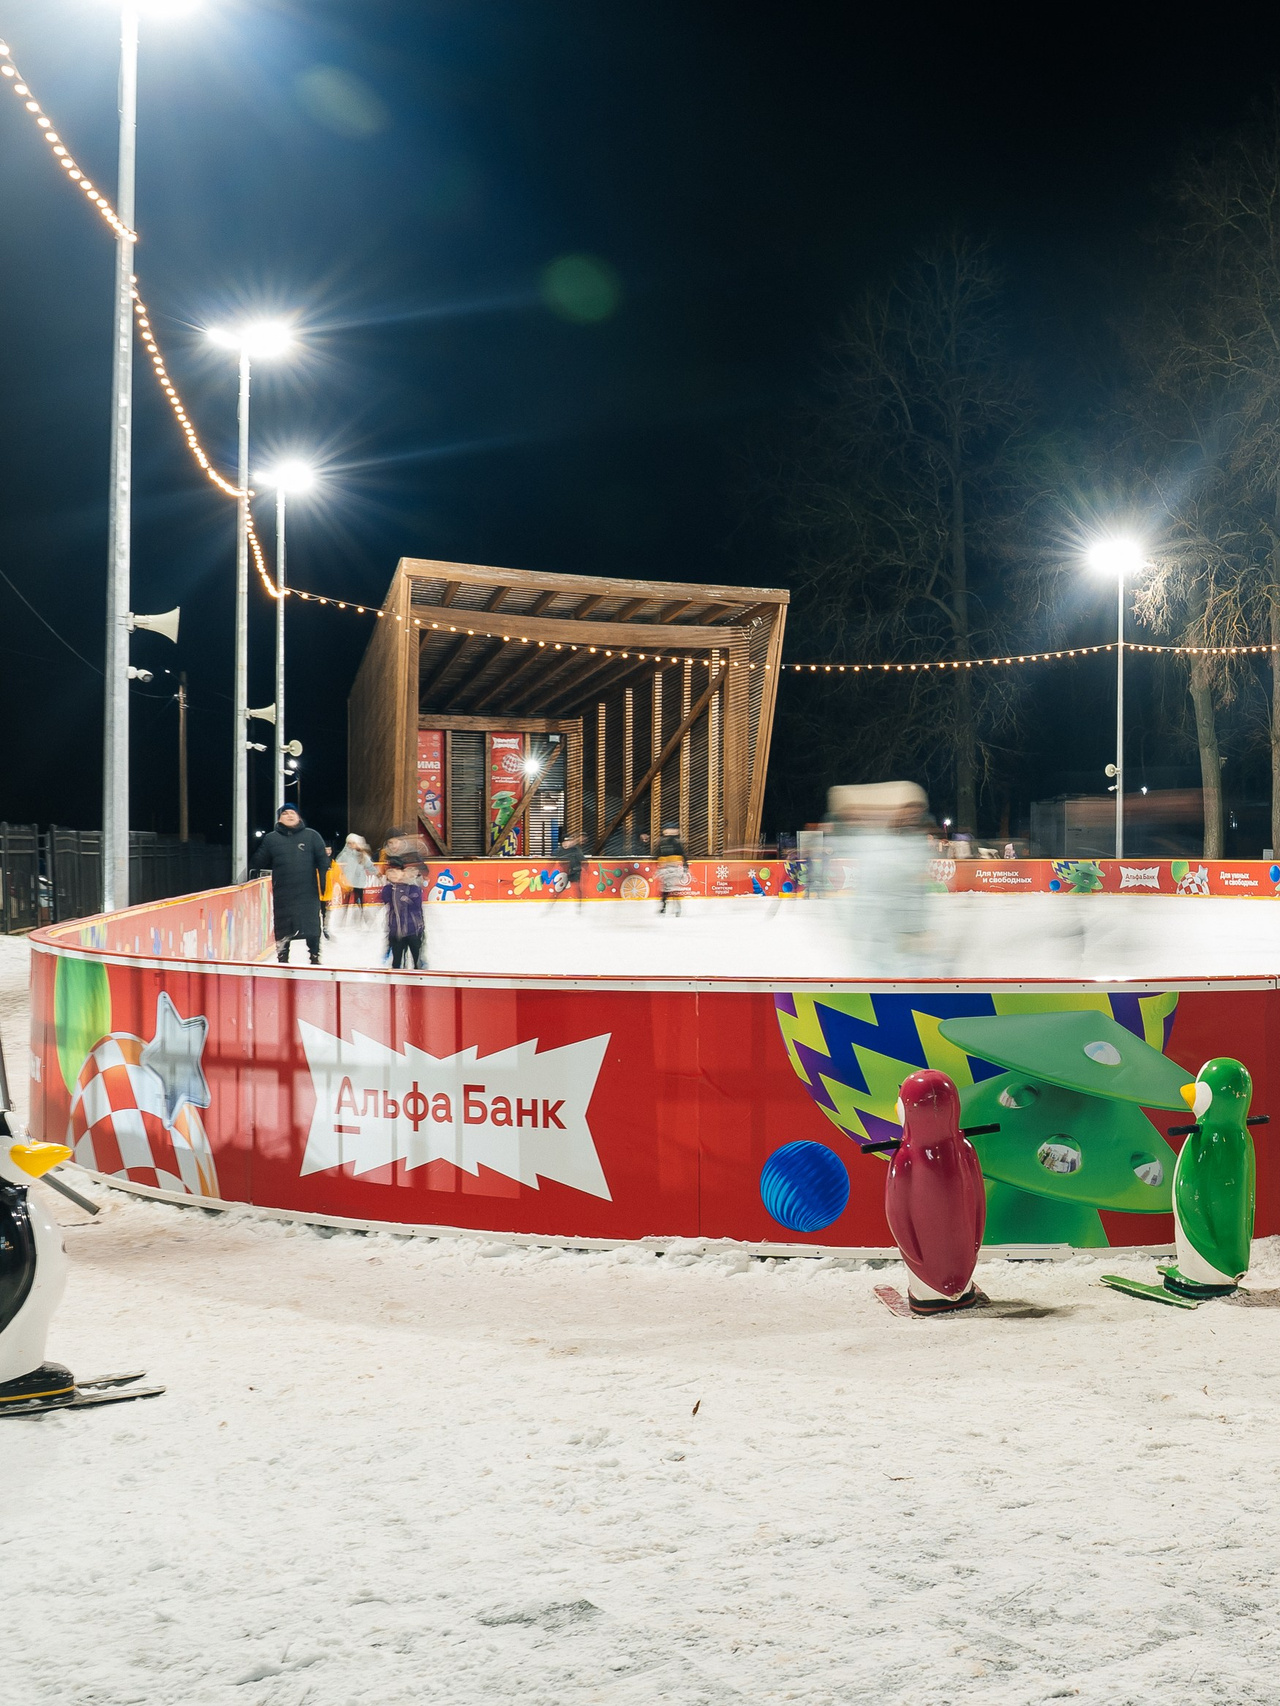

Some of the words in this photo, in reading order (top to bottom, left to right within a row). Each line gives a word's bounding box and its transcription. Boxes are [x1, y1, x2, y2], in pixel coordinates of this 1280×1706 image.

[1220, 871, 1231, 880] Для
[989, 876, 1032, 884] свободных
[1229, 879, 1258, 887] свободных
[333, 1075, 453, 1132] Альфа
[463, 1083, 568, 1130] Банк
